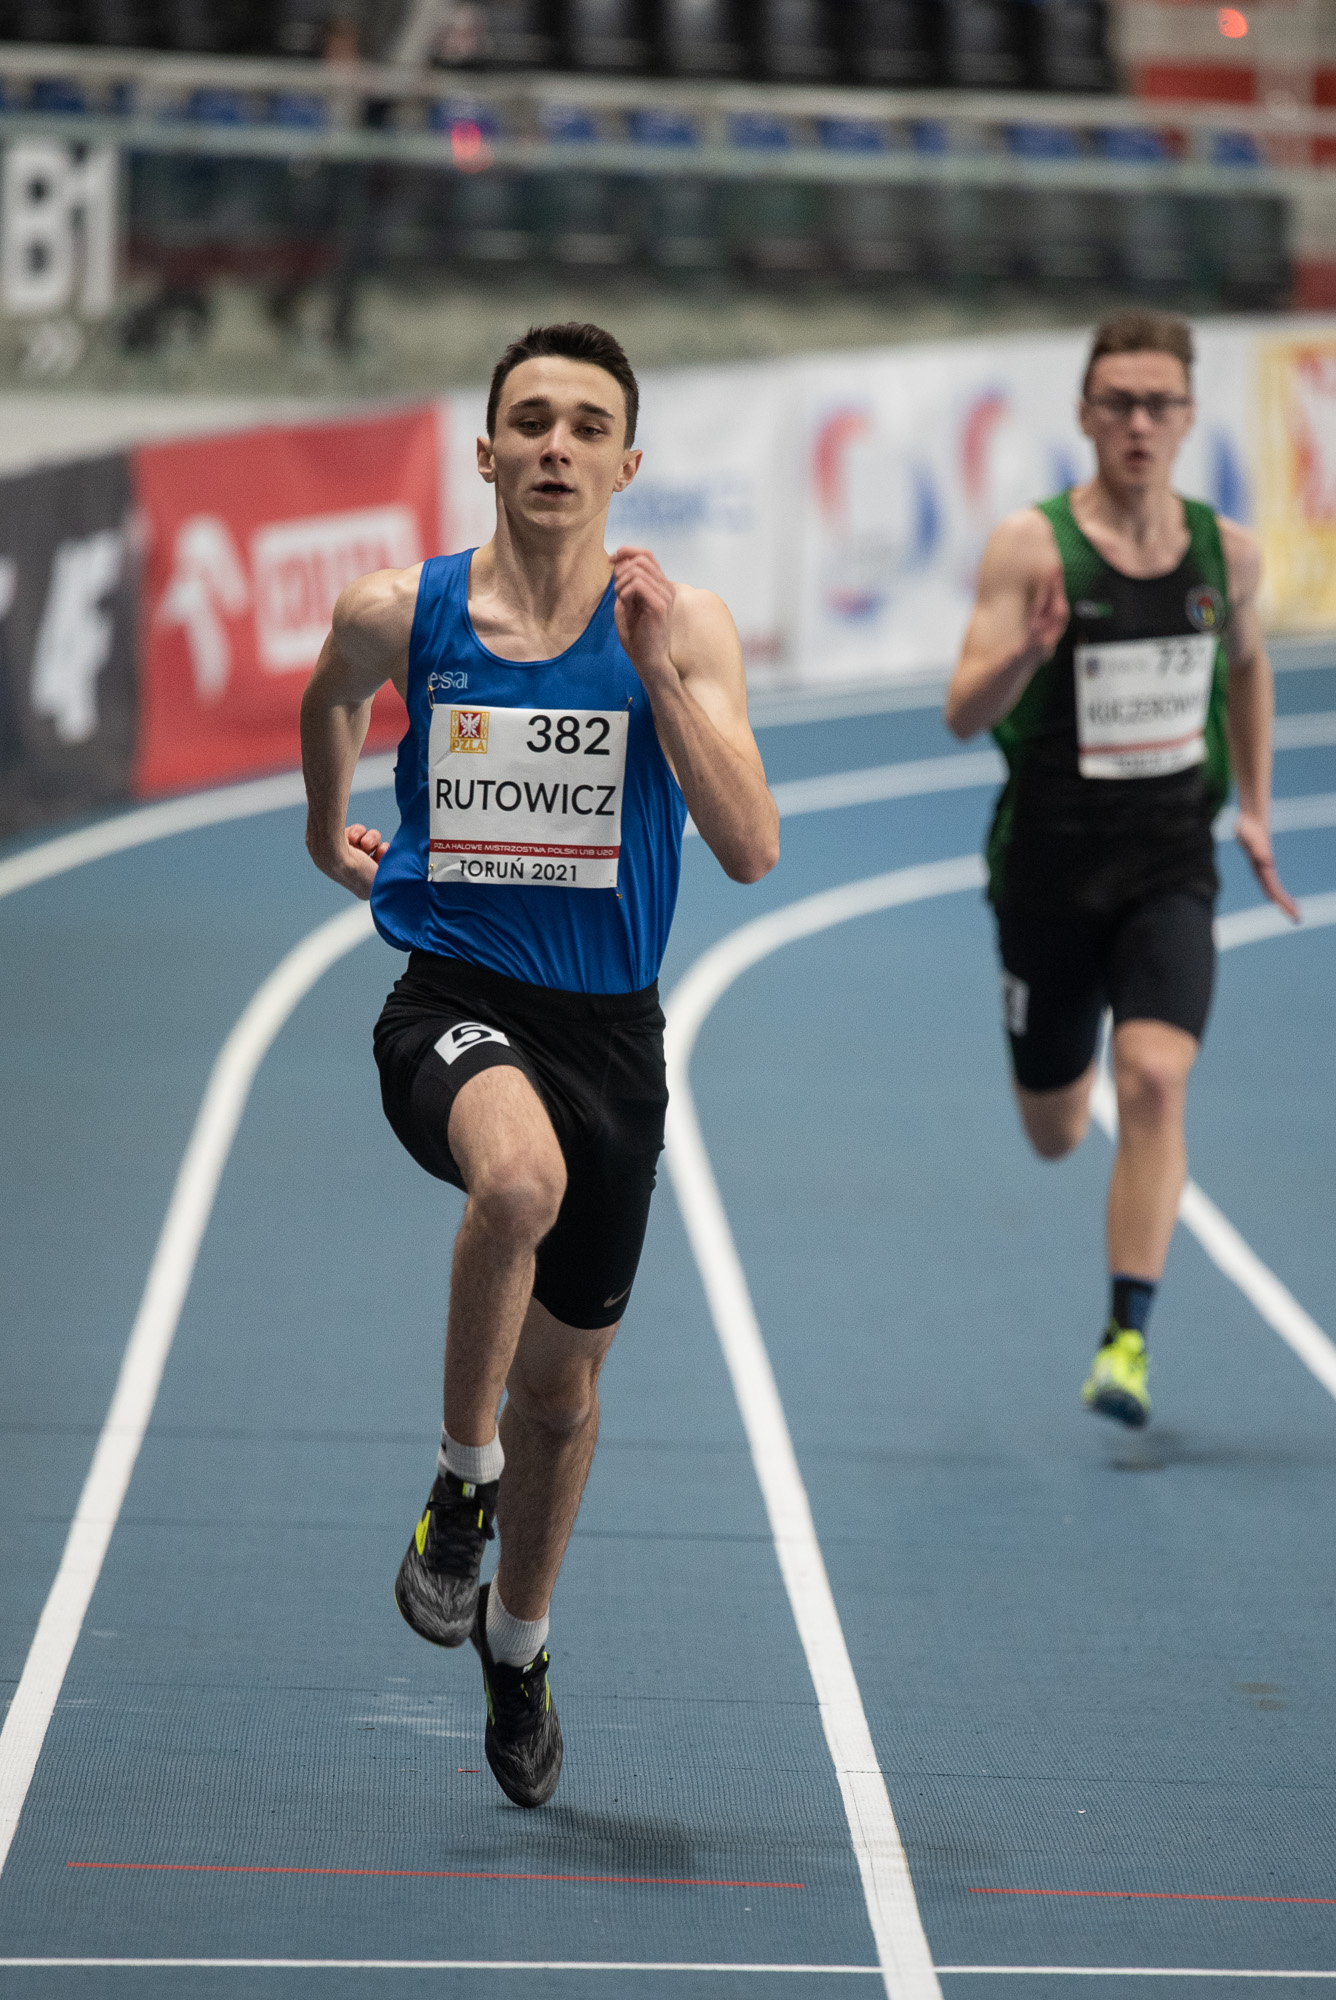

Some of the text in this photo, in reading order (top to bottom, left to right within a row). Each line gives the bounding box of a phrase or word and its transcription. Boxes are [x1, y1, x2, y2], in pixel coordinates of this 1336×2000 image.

[3, 138, 118, 314] B1
[452, 739, 485, 752] PZLA
[526, 714, 611, 756] 382
[436, 778, 617, 816] RUTOWICZ
[433, 842, 451, 850] PZLA
[484, 845, 547, 854] MISTRZOSTWA
[547, 847, 578, 855] POLSKI
[460, 857, 577, 882] TORUŃ 2021
[451, 1024, 492, 1049] 5
